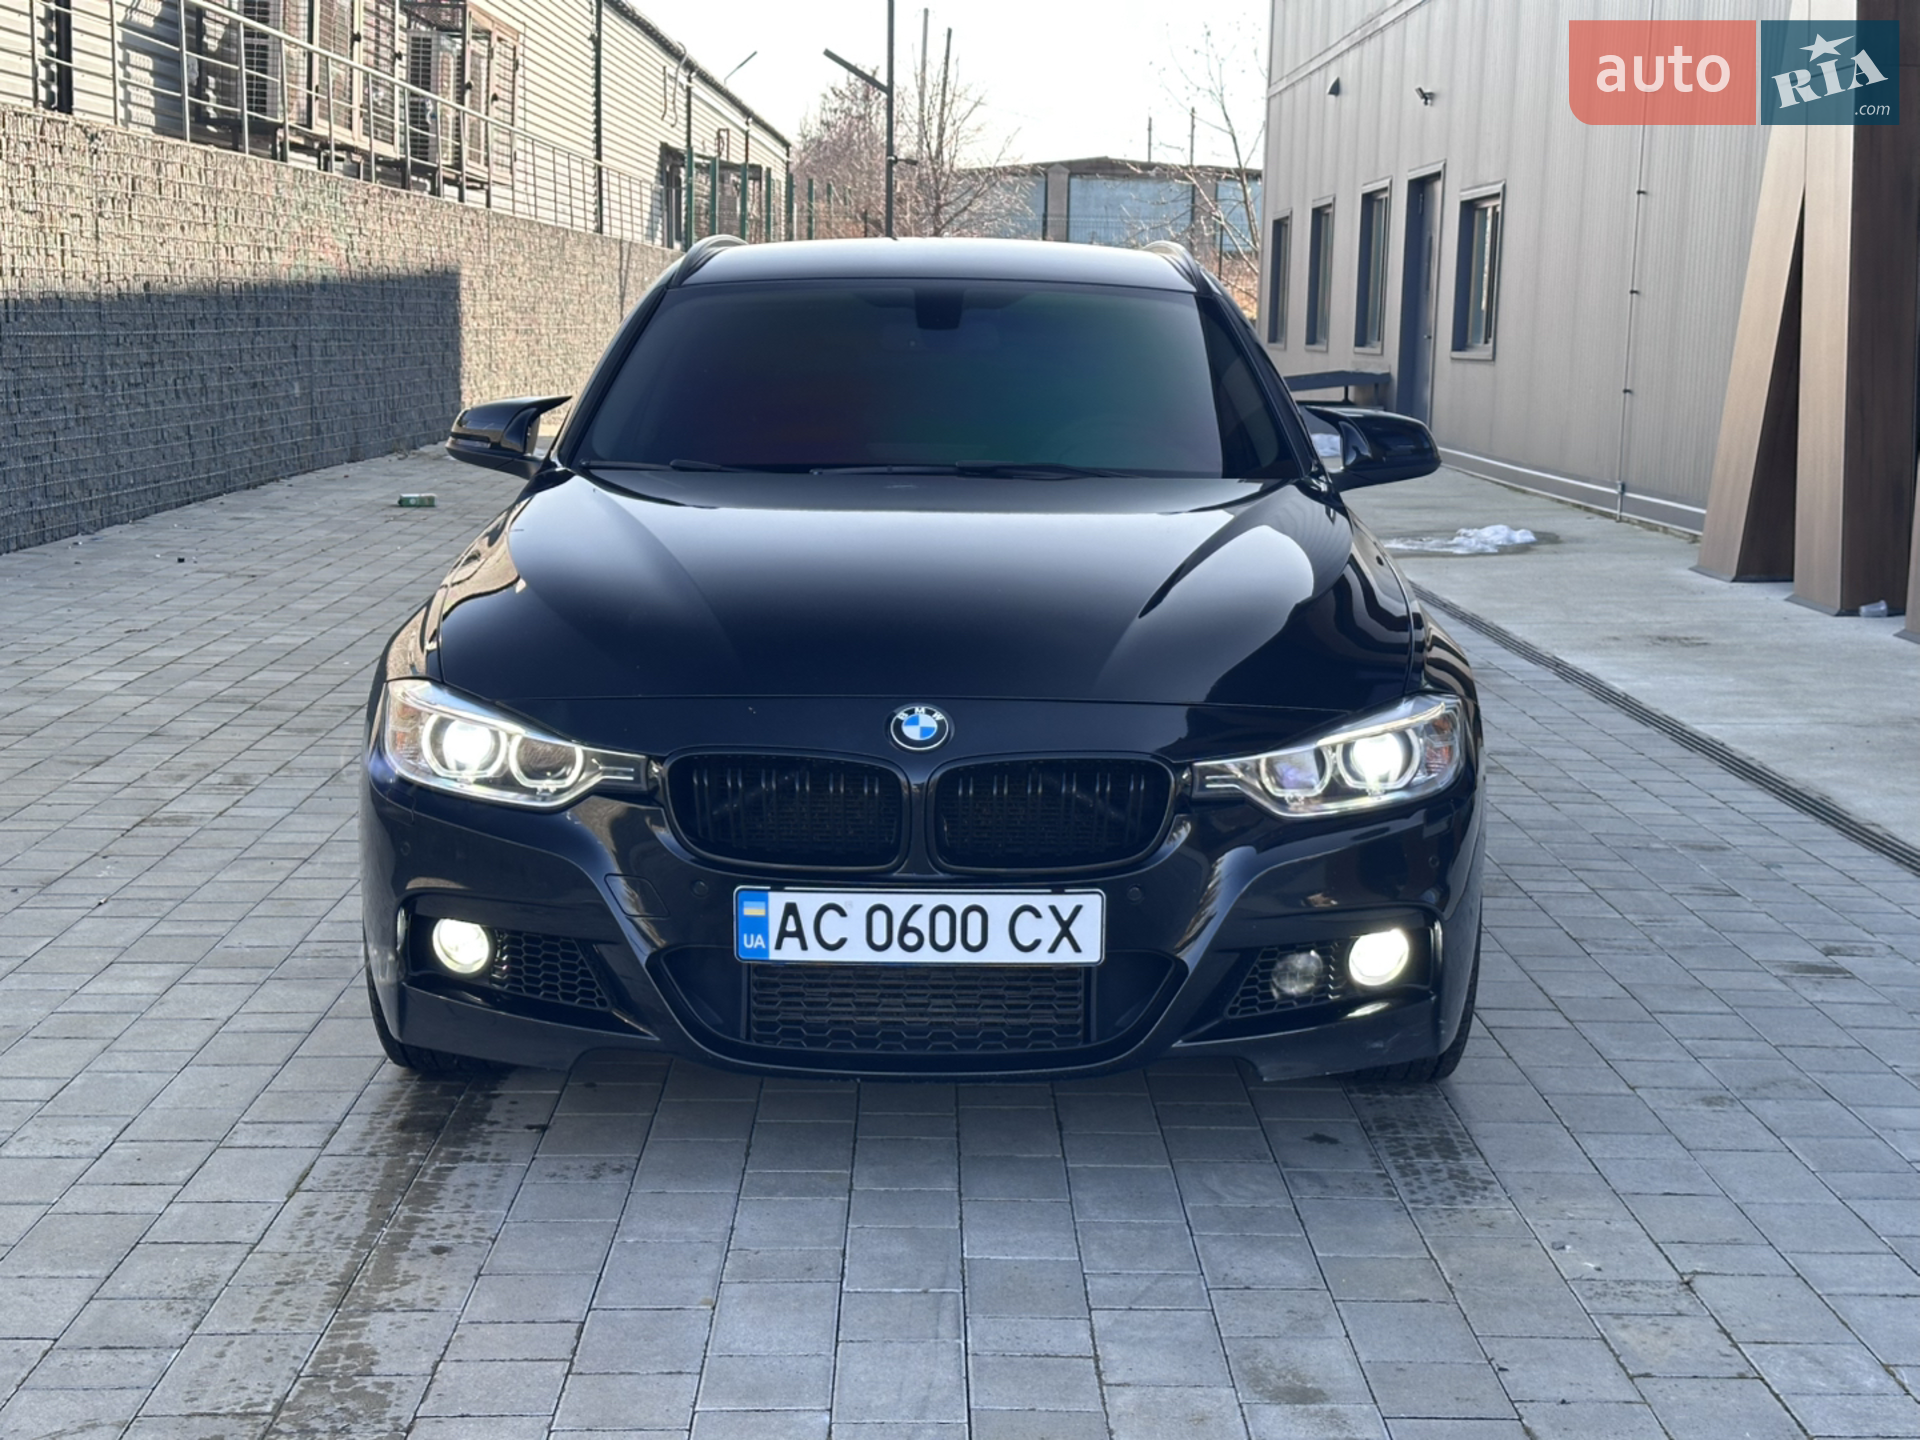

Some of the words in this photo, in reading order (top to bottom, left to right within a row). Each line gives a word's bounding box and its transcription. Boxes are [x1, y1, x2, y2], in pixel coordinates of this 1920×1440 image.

[743, 933, 766, 949] UA
[774, 902, 848, 951] AC
[865, 903, 988, 953] 0600
[1008, 904, 1083, 953] CX
